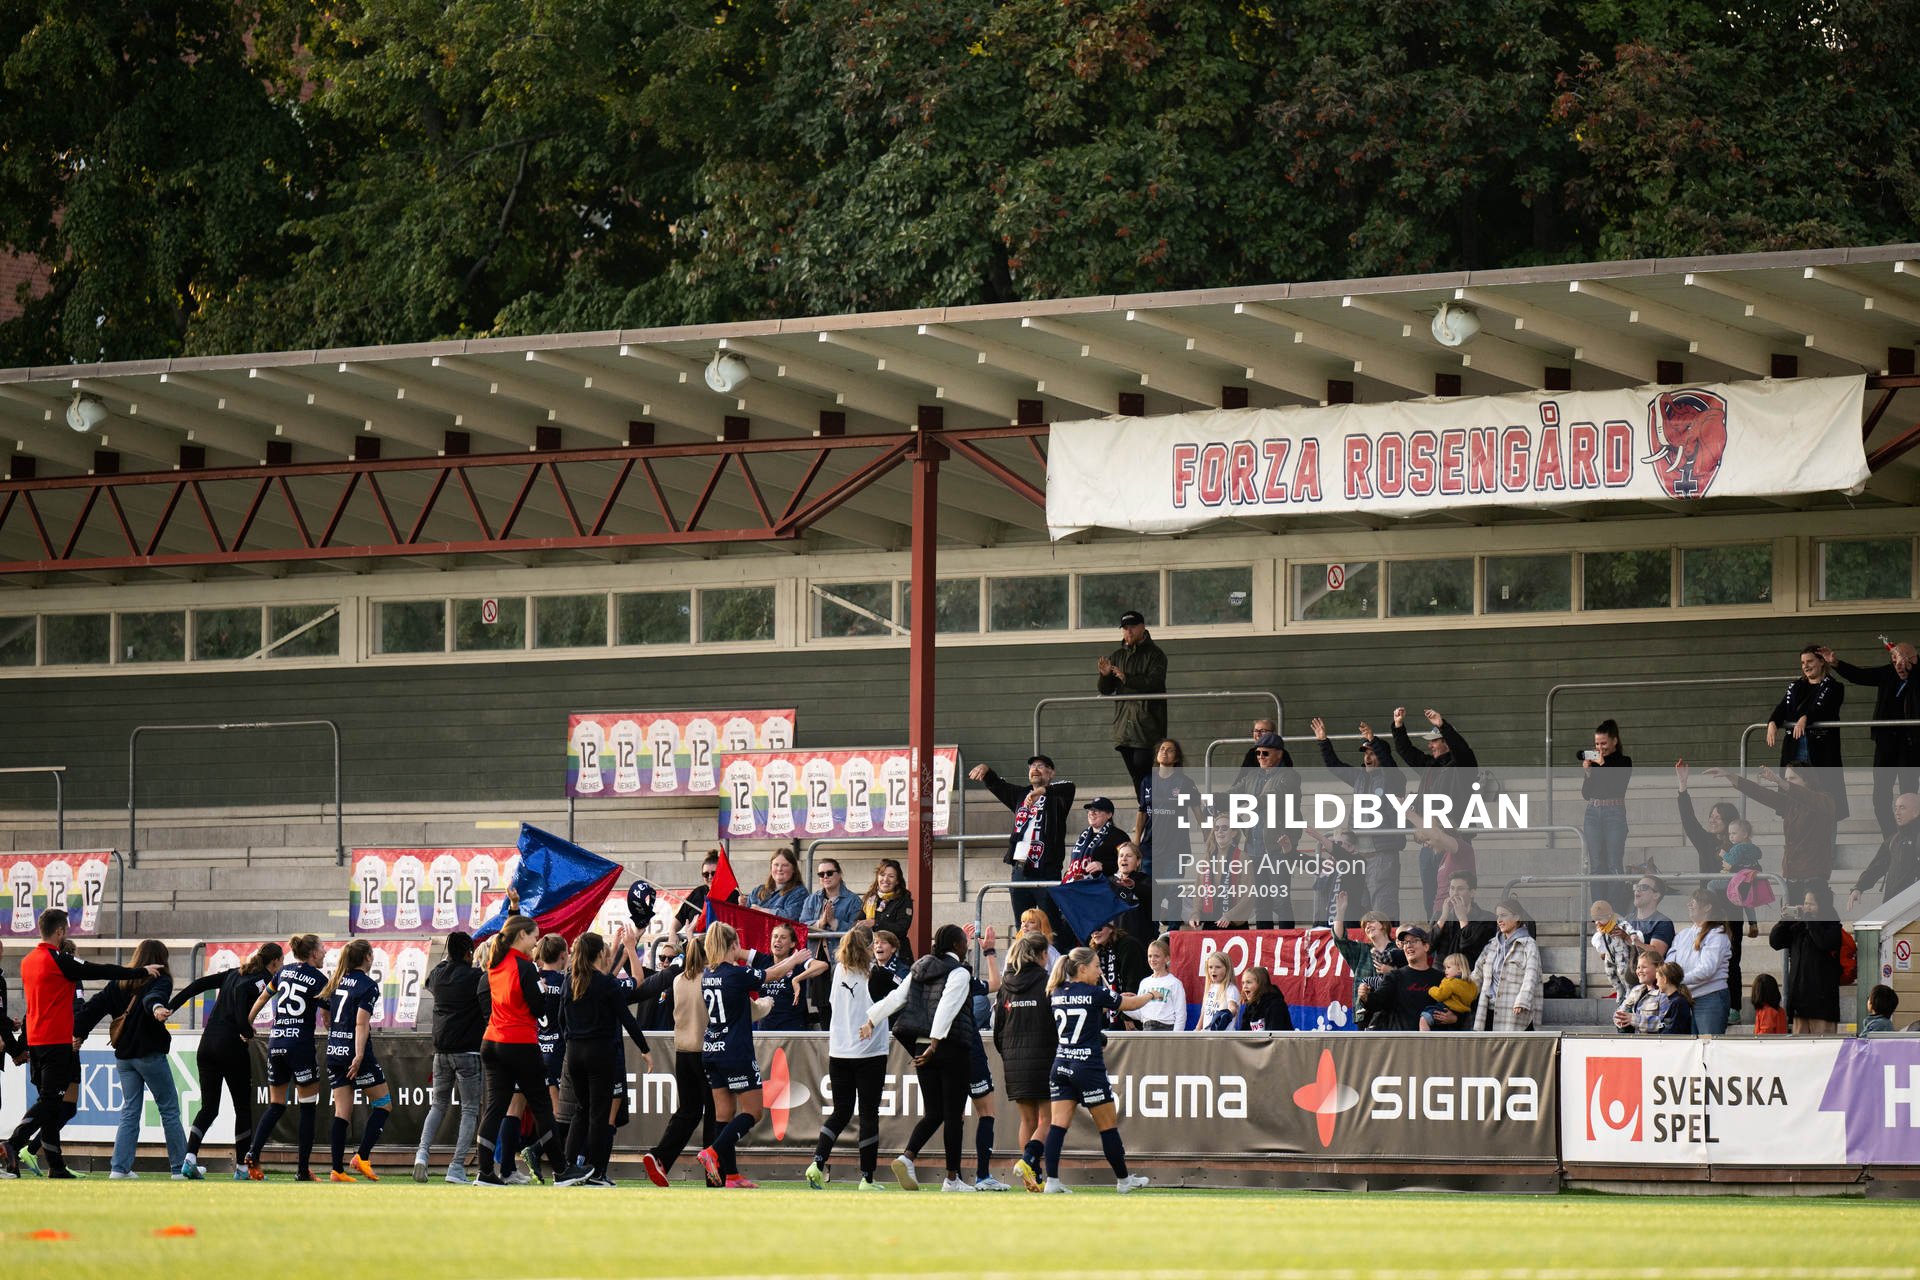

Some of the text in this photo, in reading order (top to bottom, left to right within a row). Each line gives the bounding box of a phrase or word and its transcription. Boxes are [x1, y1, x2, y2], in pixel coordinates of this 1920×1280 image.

[1173, 401, 1634, 508] FORZA ROSENGÅRD
[277, 981, 308, 1017] 25
[334, 989, 349, 1023] 7
[703, 988, 727, 1024] 21
[1054, 1008, 1088, 1045] 27
[78, 1064, 126, 1112] KB
[399, 1087, 460, 1106] HOTL
[1653, 1075, 1788, 1107] SVENSKA
[1653, 1114, 1720, 1143] SPEL
